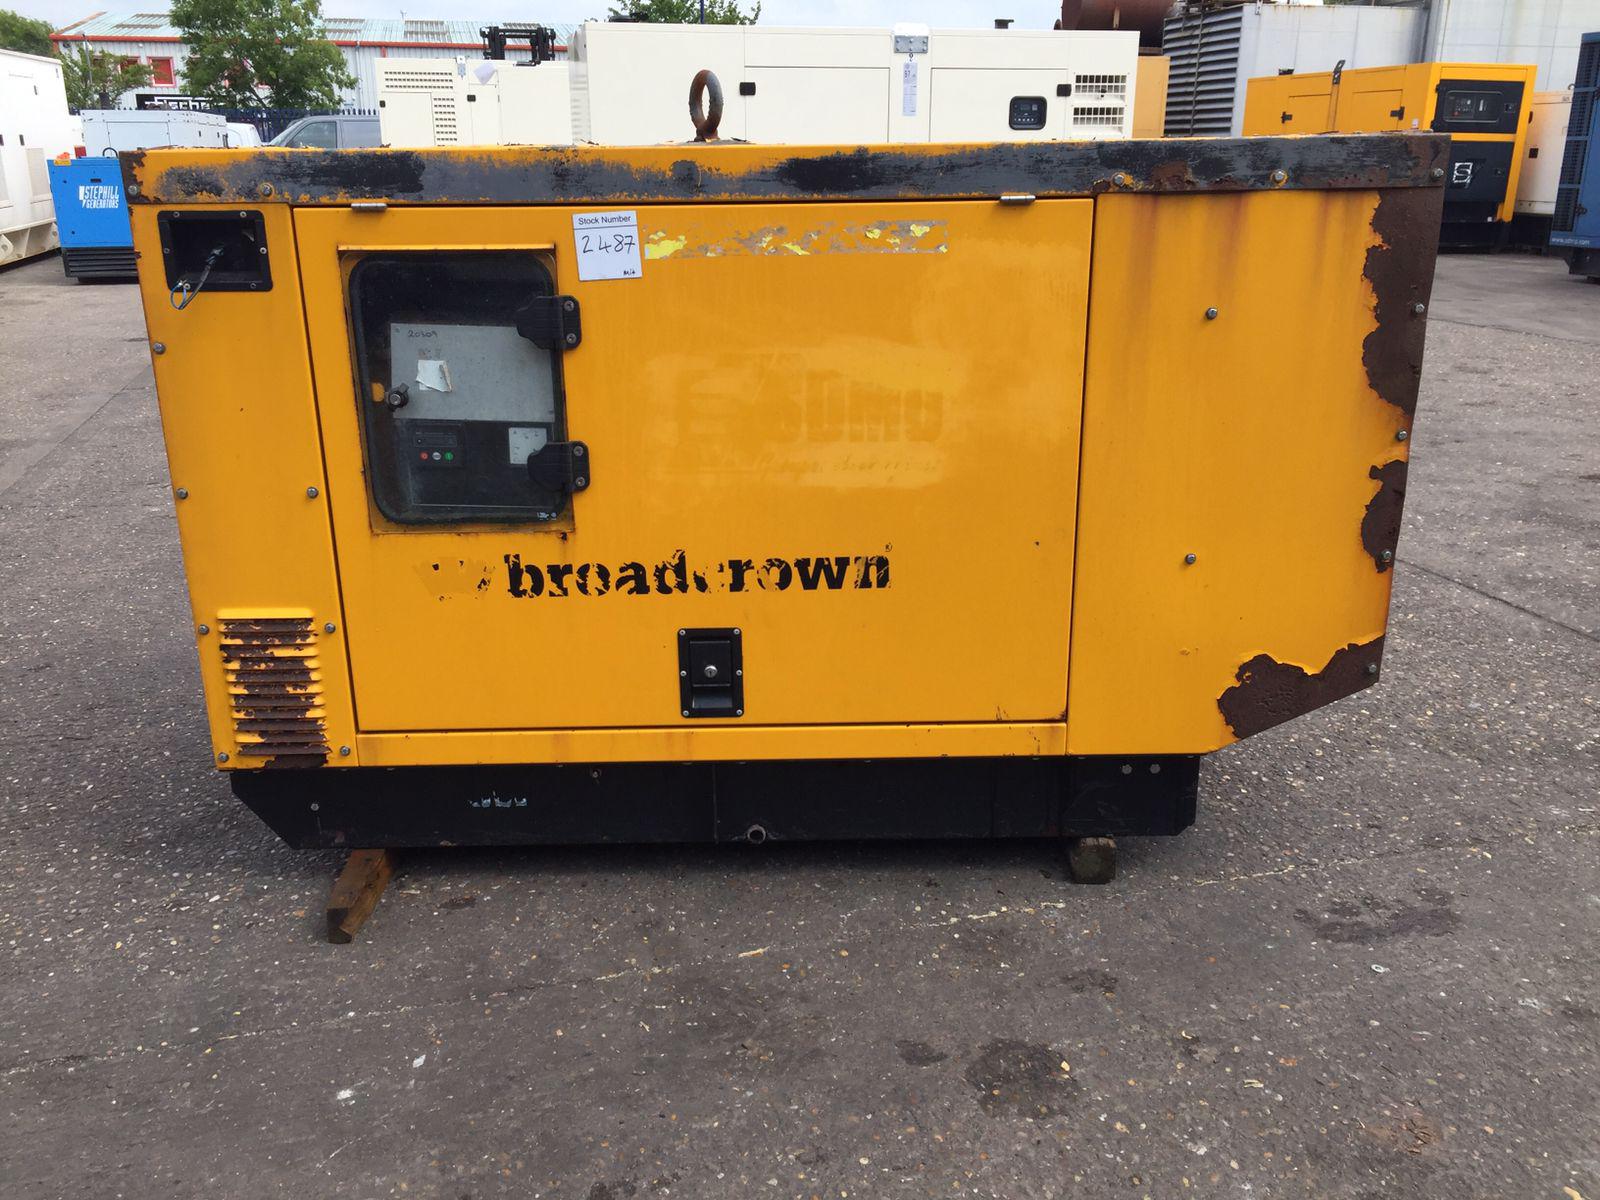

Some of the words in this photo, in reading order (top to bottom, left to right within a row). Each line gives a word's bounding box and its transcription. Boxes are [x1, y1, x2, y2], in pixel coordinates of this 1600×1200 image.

[84, 185, 120, 199] STEPHILL
[578, 217, 600, 226] Stock
[601, 215, 631, 224] Number
[581, 233, 636, 256] 2487
